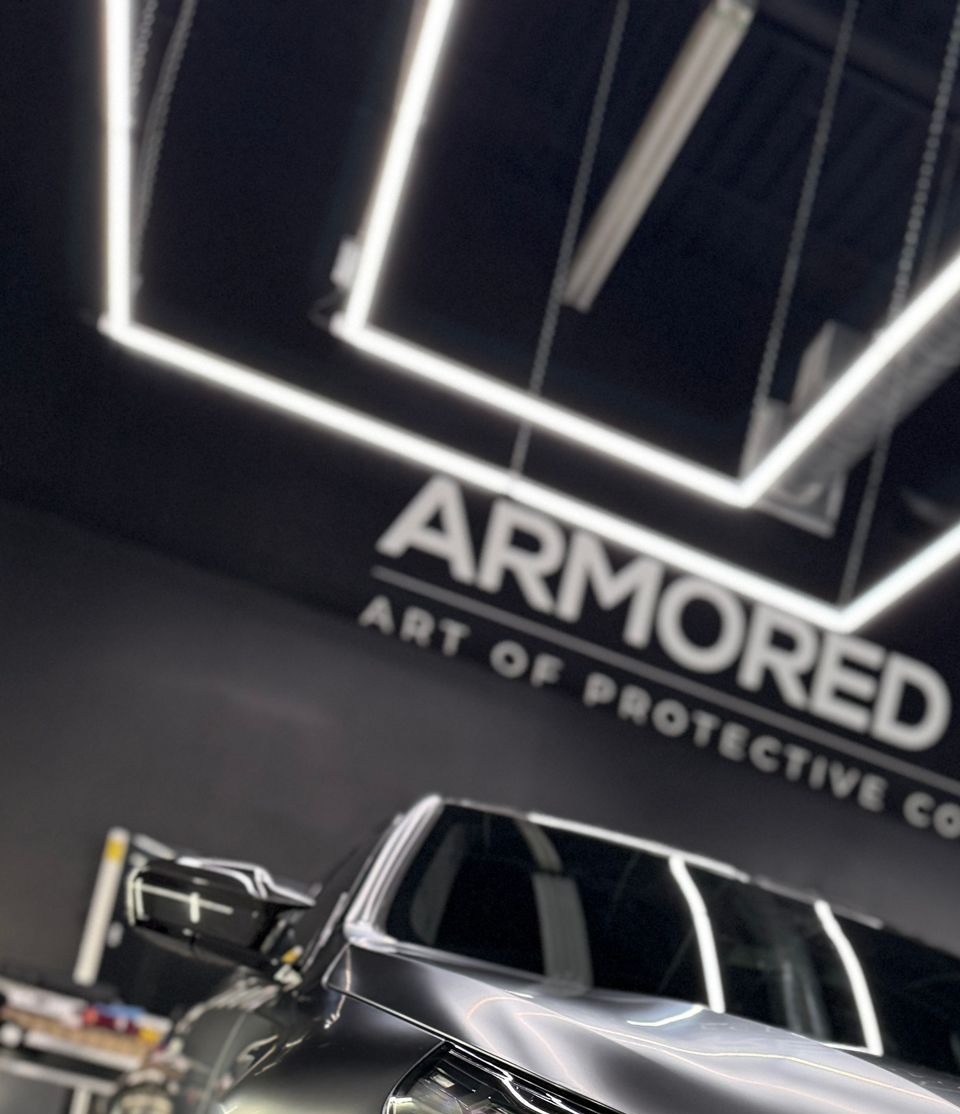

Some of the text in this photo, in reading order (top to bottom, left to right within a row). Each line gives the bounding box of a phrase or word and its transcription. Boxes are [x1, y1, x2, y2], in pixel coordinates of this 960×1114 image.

[358, 595, 471, 657] ART
[489, 640, 564, 689] OF
[582, 672, 888, 812] PROTECTIVE
[375, 474, 951, 752] ARMORED
